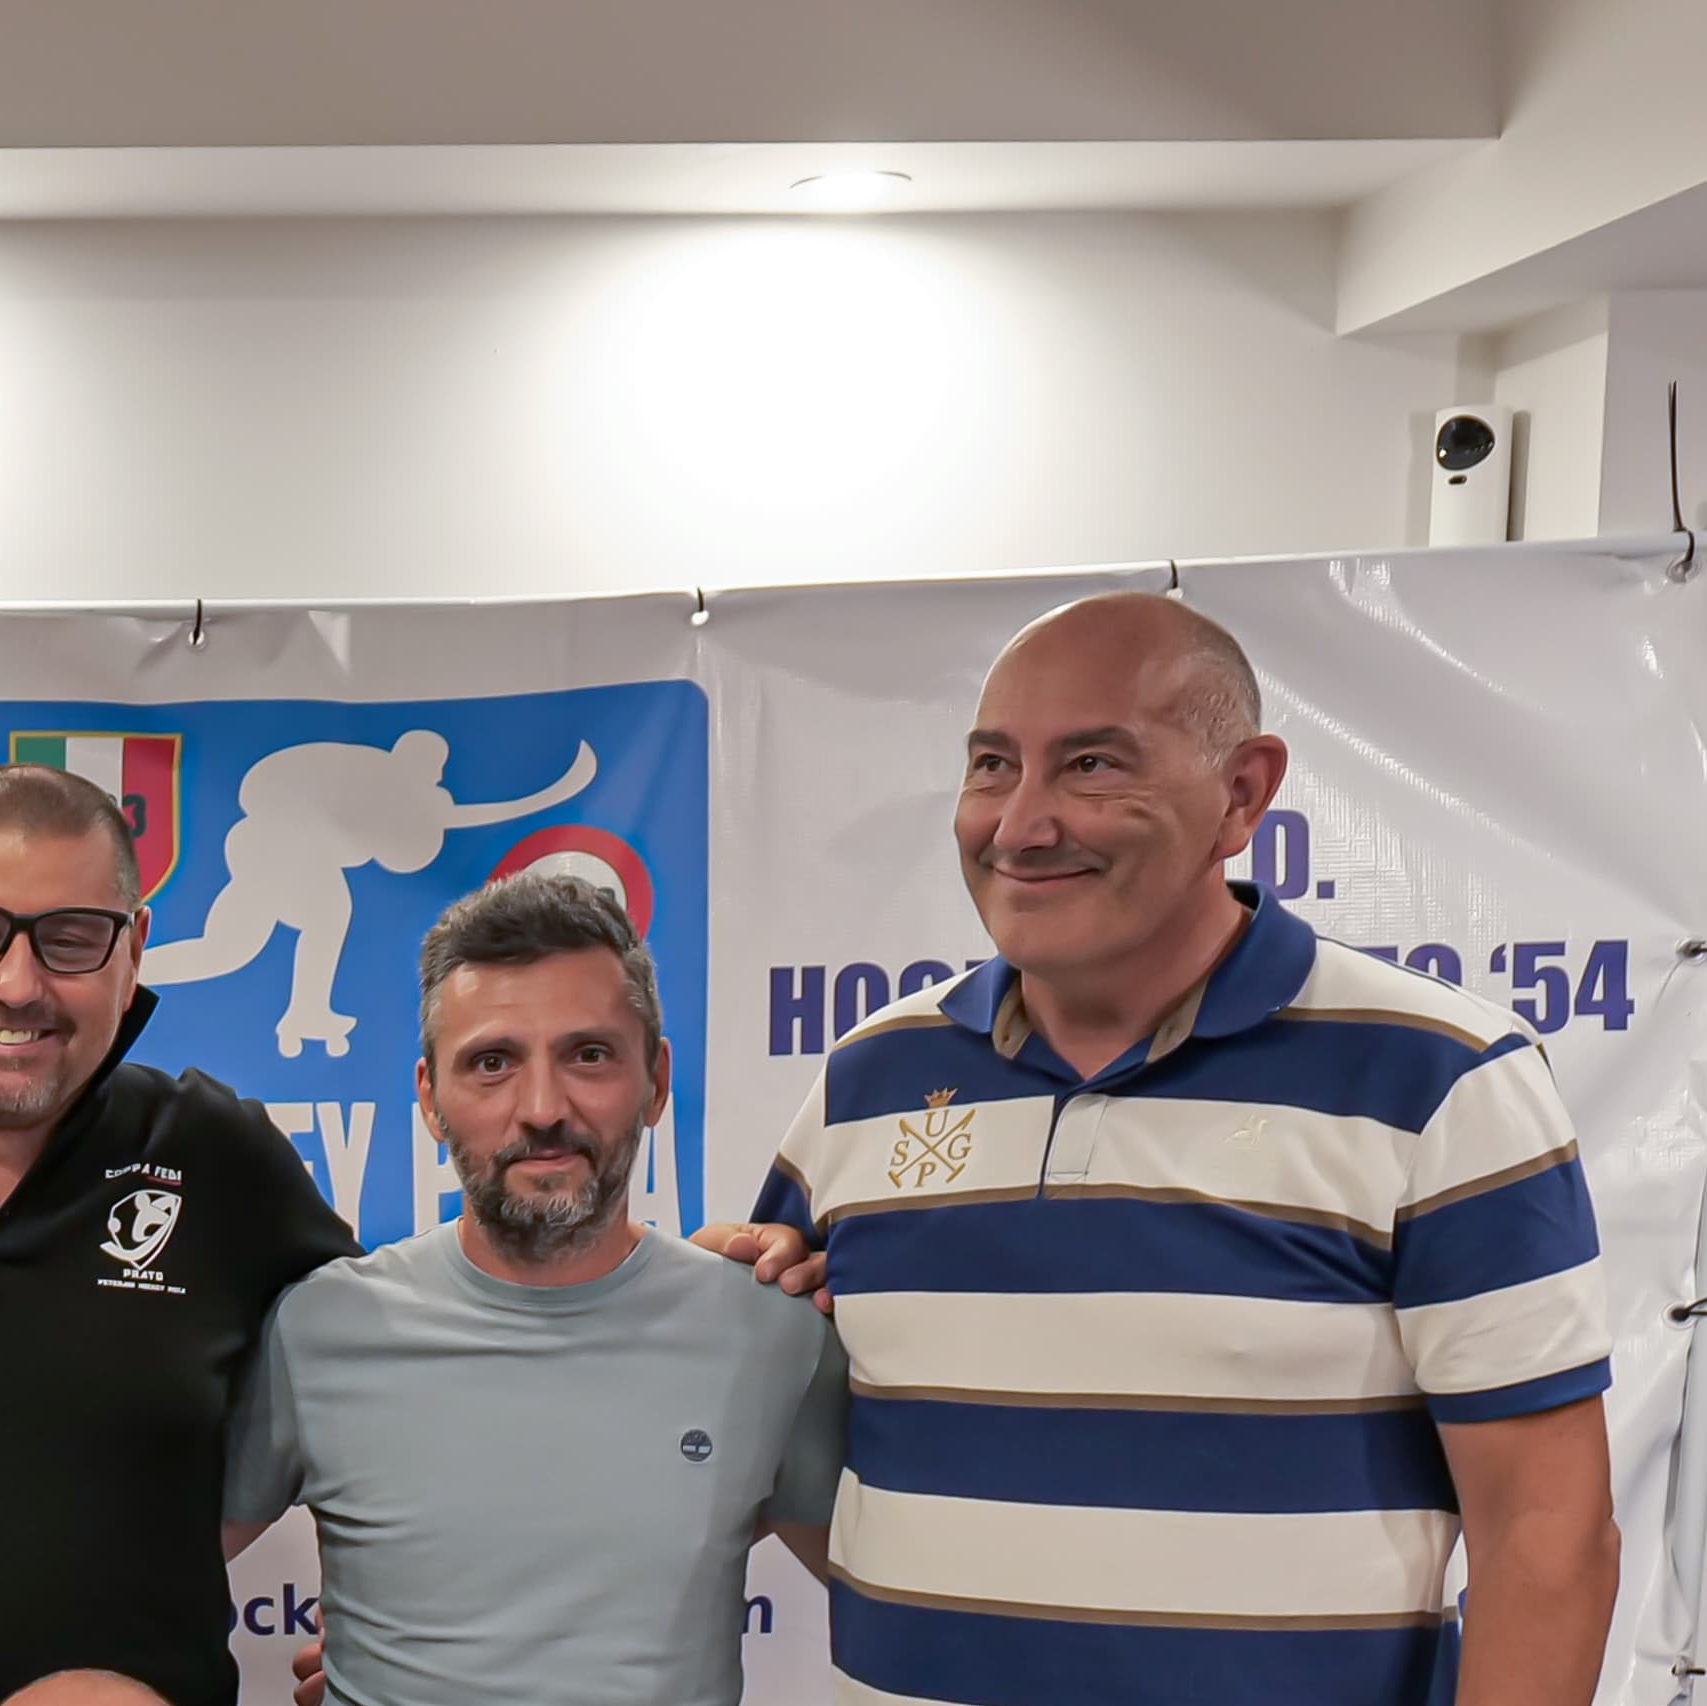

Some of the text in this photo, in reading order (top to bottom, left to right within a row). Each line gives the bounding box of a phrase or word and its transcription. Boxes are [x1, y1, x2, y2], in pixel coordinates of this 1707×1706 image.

[105, 1163, 182, 1181] COPPA FEDI
[123, 1268, 164, 1282] PRATO
